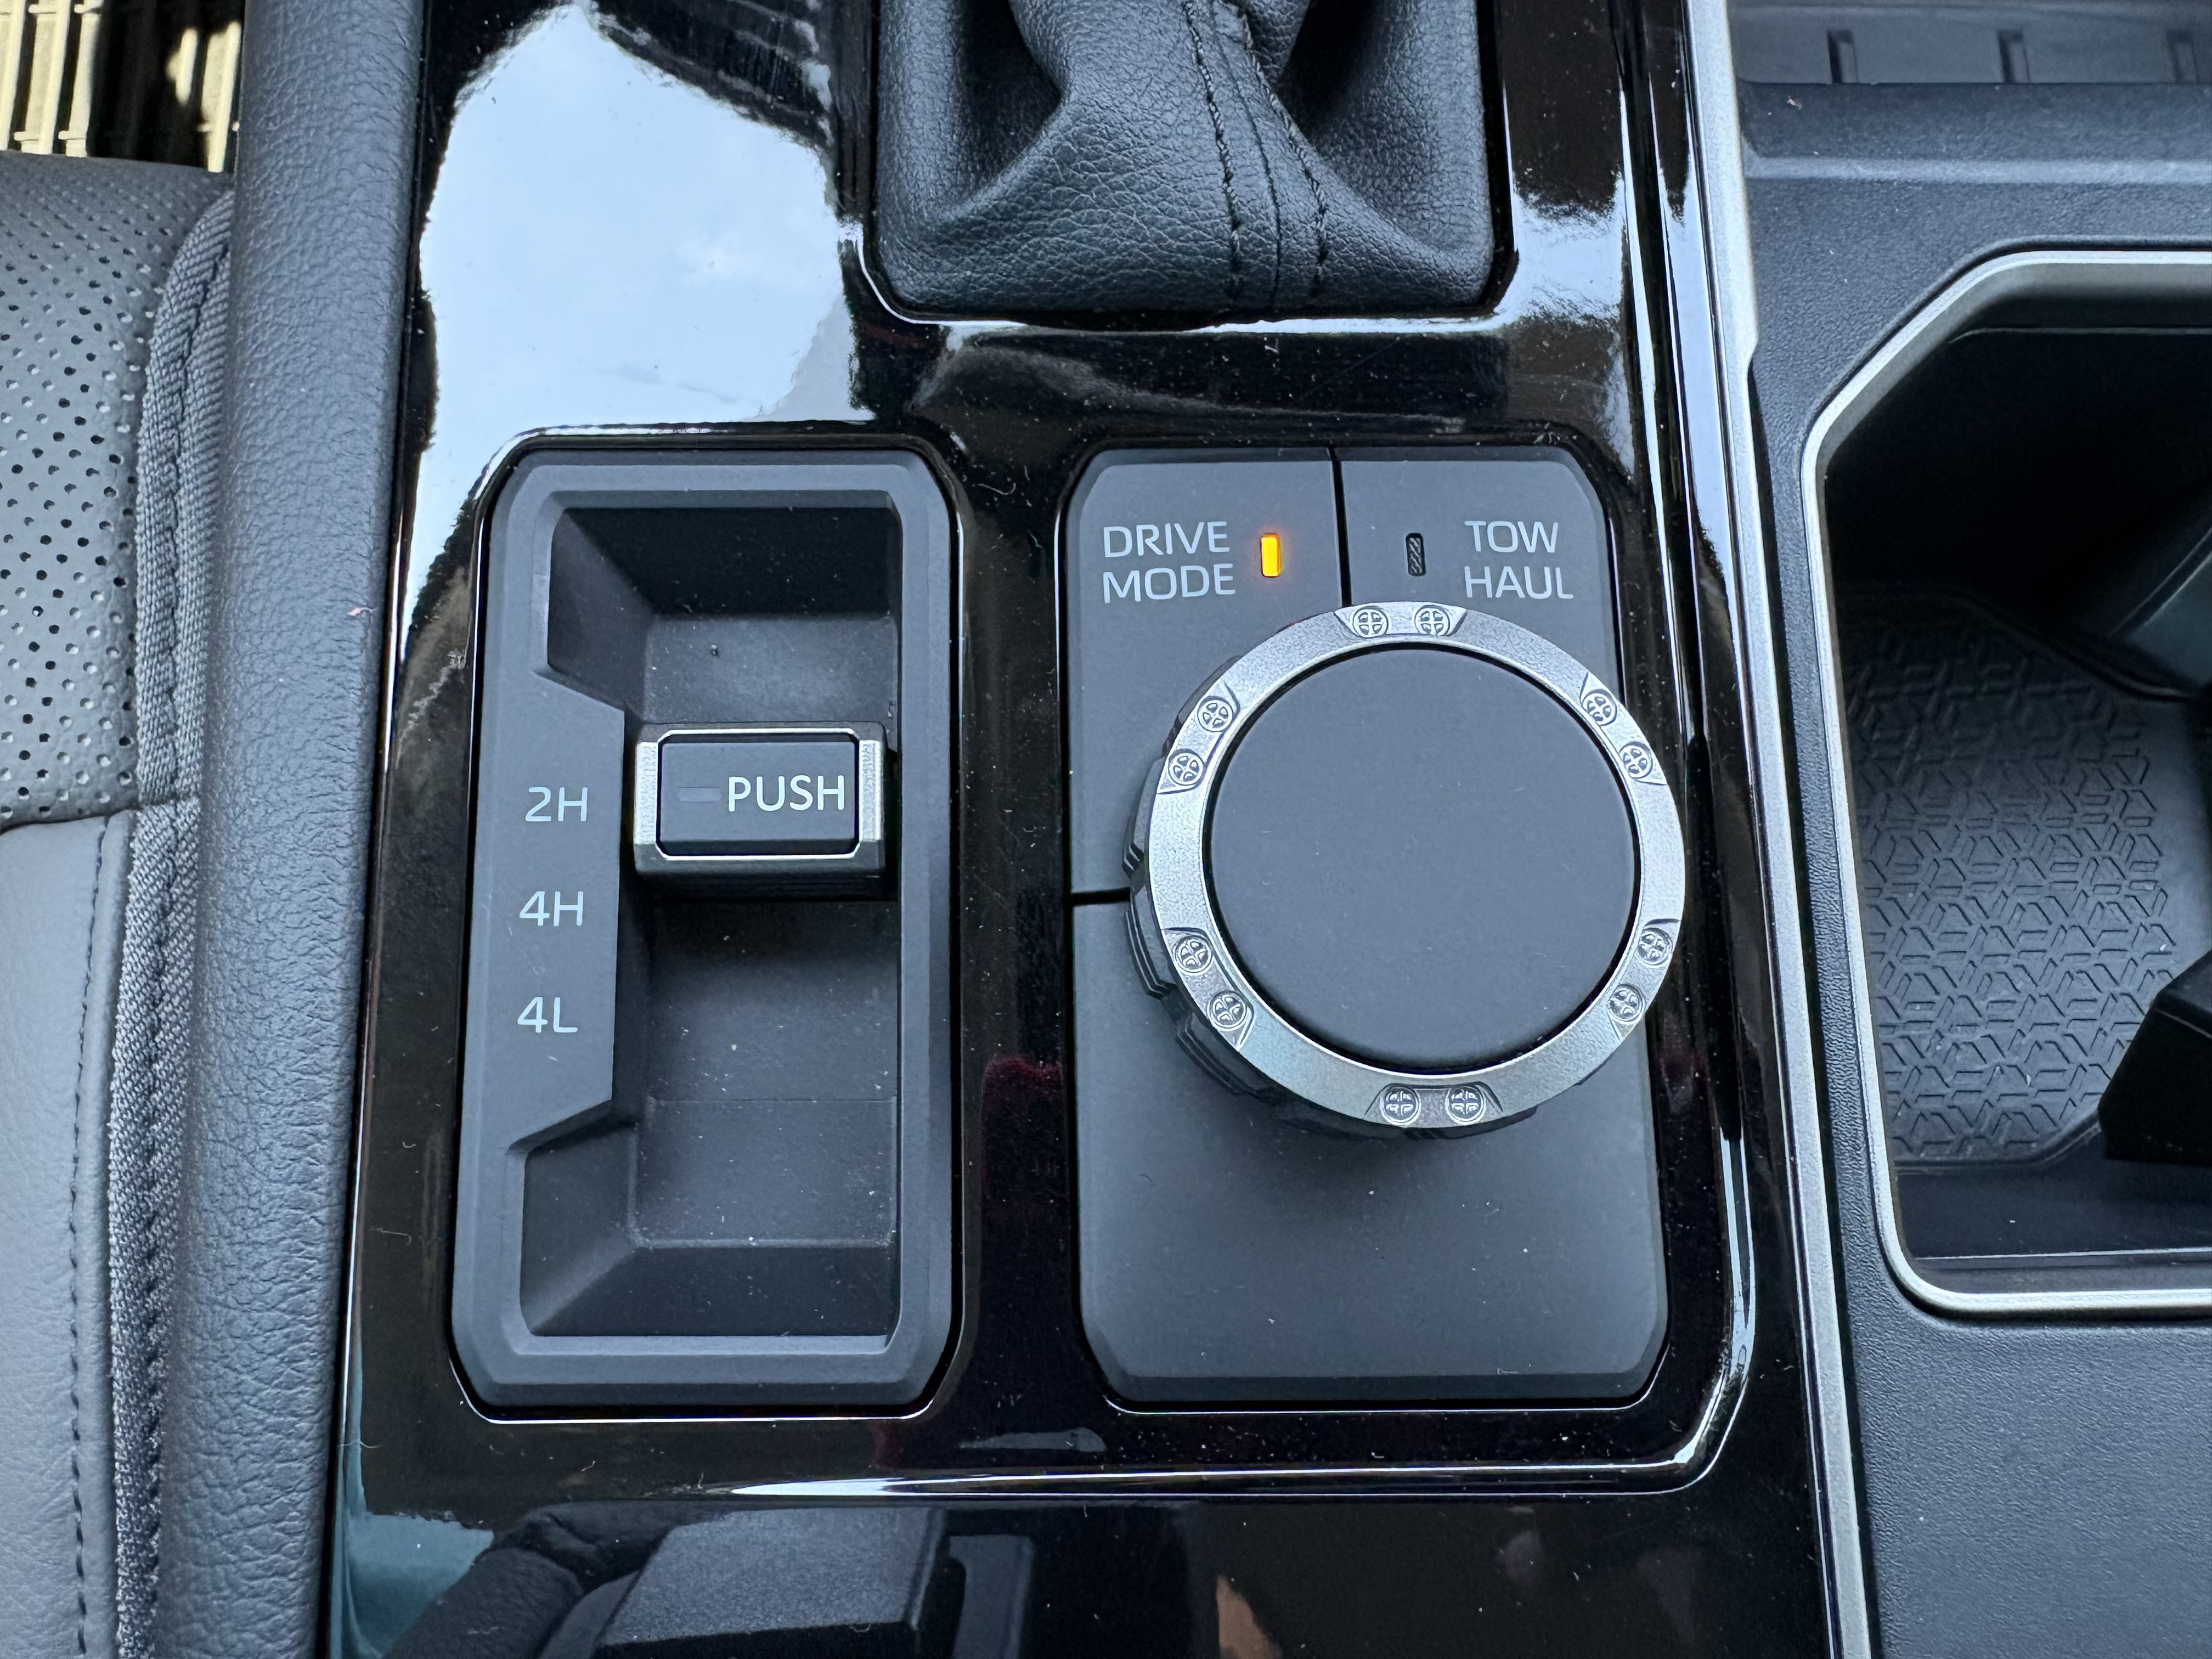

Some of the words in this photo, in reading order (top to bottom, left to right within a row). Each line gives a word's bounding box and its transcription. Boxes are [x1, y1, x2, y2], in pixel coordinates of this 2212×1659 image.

[1103, 521, 1231, 558] DRIVE
[1464, 521, 1559, 553] TOW
[1103, 563, 1236, 603] MODE
[1464, 566, 1574, 600] HAUL
[525, 786, 588, 822] 2H
[728, 775, 845, 812] PUSH
[519, 891, 584, 927] 4H
[517, 996, 578, 1033] 4L
